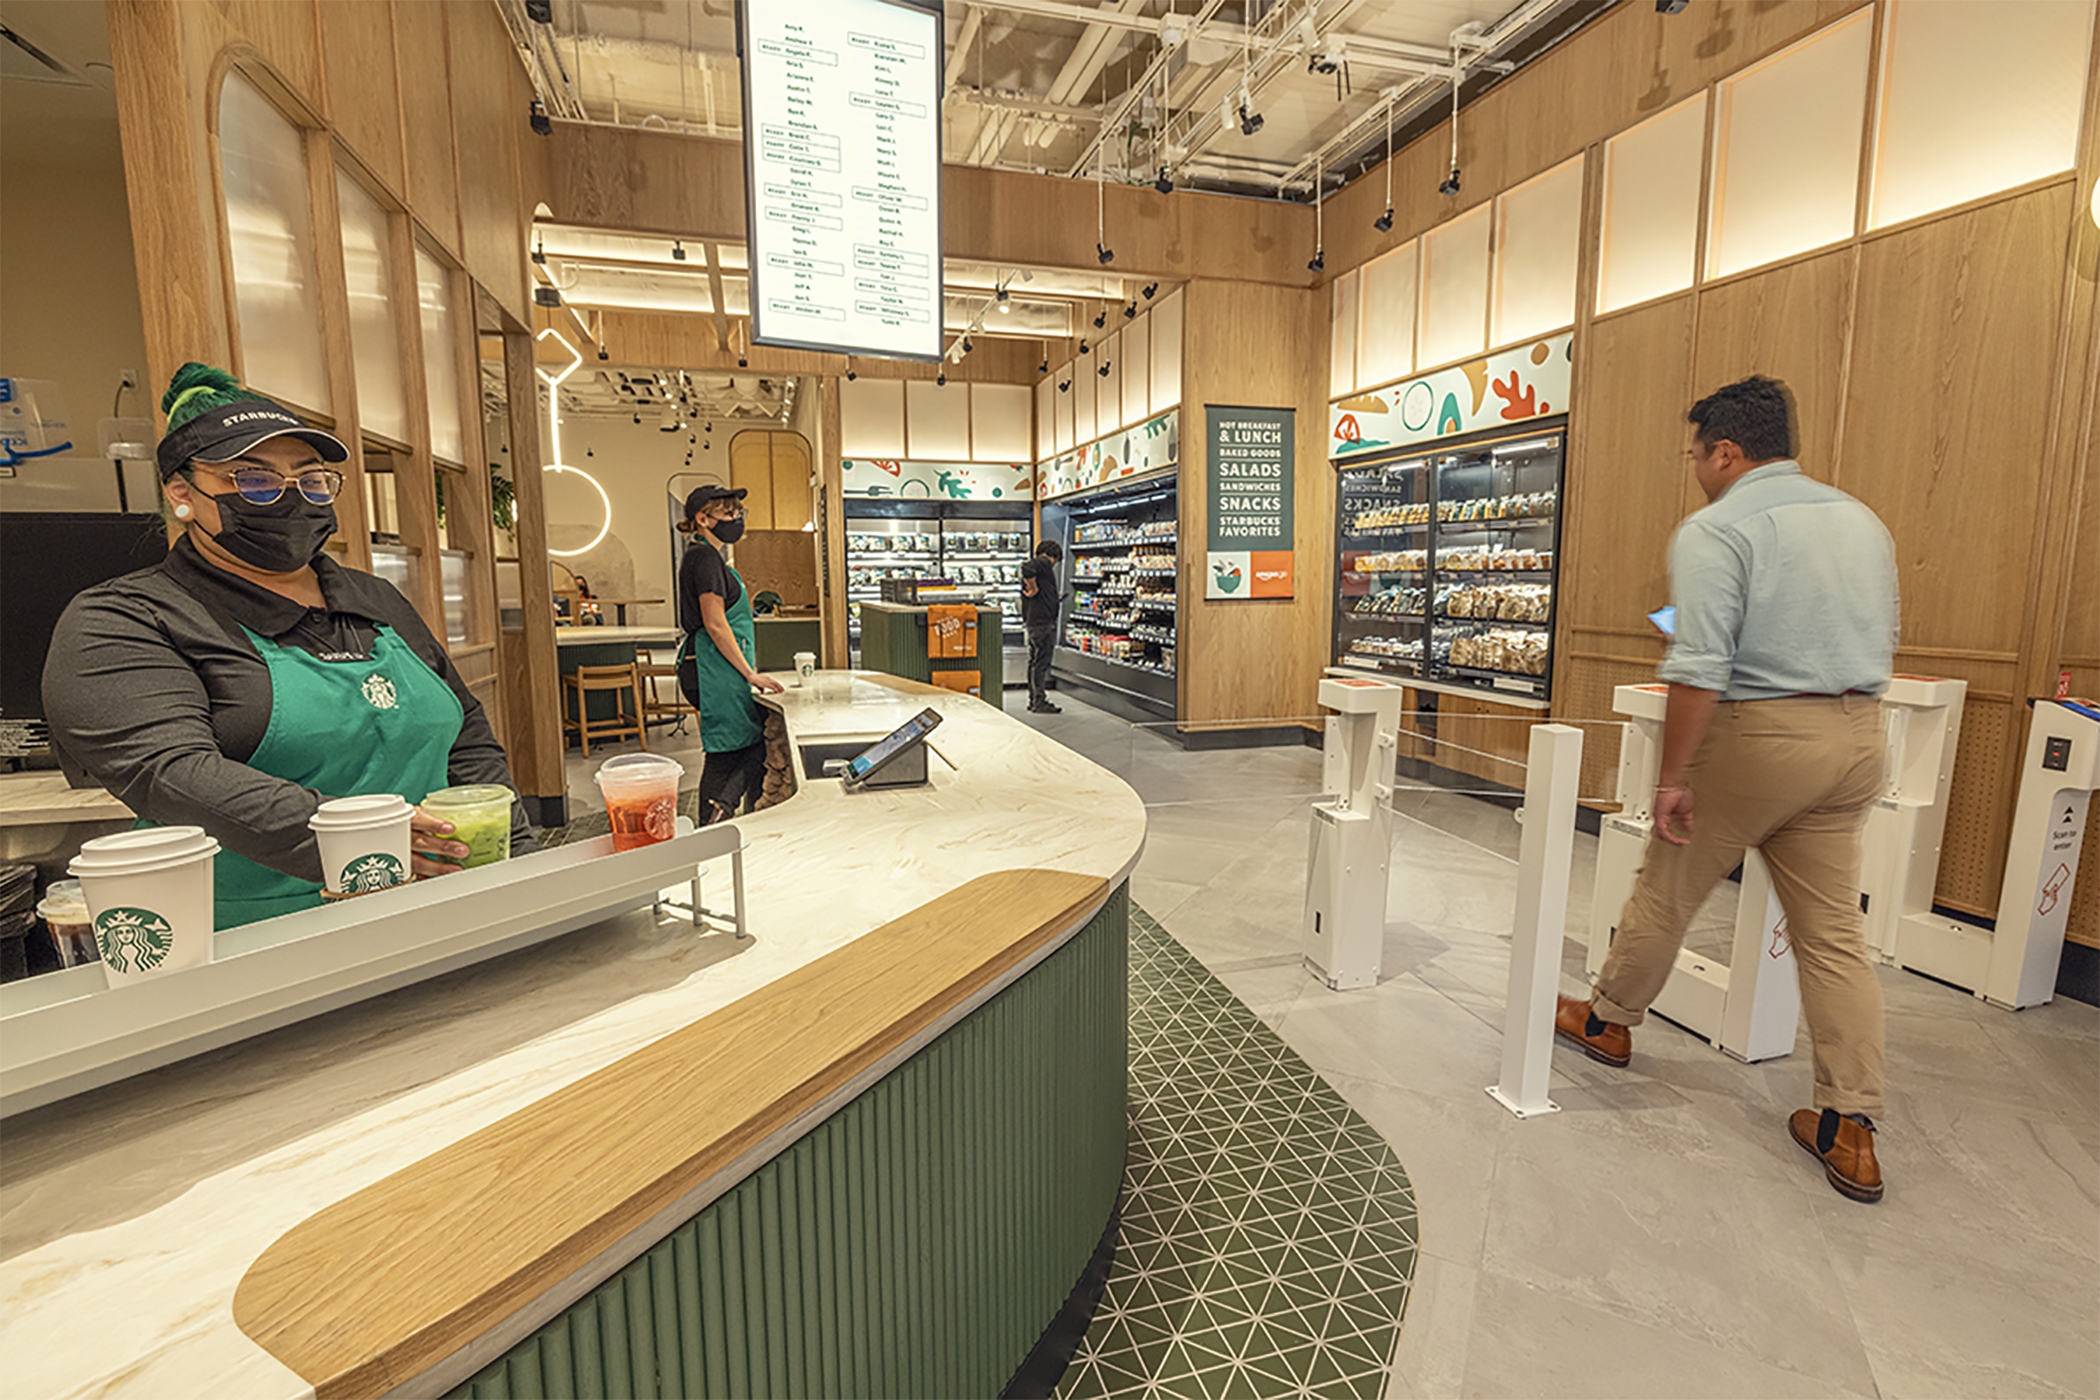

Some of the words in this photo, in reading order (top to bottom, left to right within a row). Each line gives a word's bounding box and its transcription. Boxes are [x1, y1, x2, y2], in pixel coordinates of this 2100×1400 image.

[1219, 421, 1236, 430] HOT
[1238, 422, 1281, 430] BREAKFAST
[1219, 431, 1230, 443] &
[1235, 431, 1282, 443] LUNCH
[1219, 448, 1248, 457] BAKED
[1250, 448, 1281, 458] GOODS
[1219, 463, 1282, 477] SALADS
[1219, 482, 1281, 492] SANDWICHES
[1219, 497, 1281, 511] SNACKS
[1219, 516, 1281, 526] STARBUCKS
[1219, 526, 1281, 537] FAVORITES
